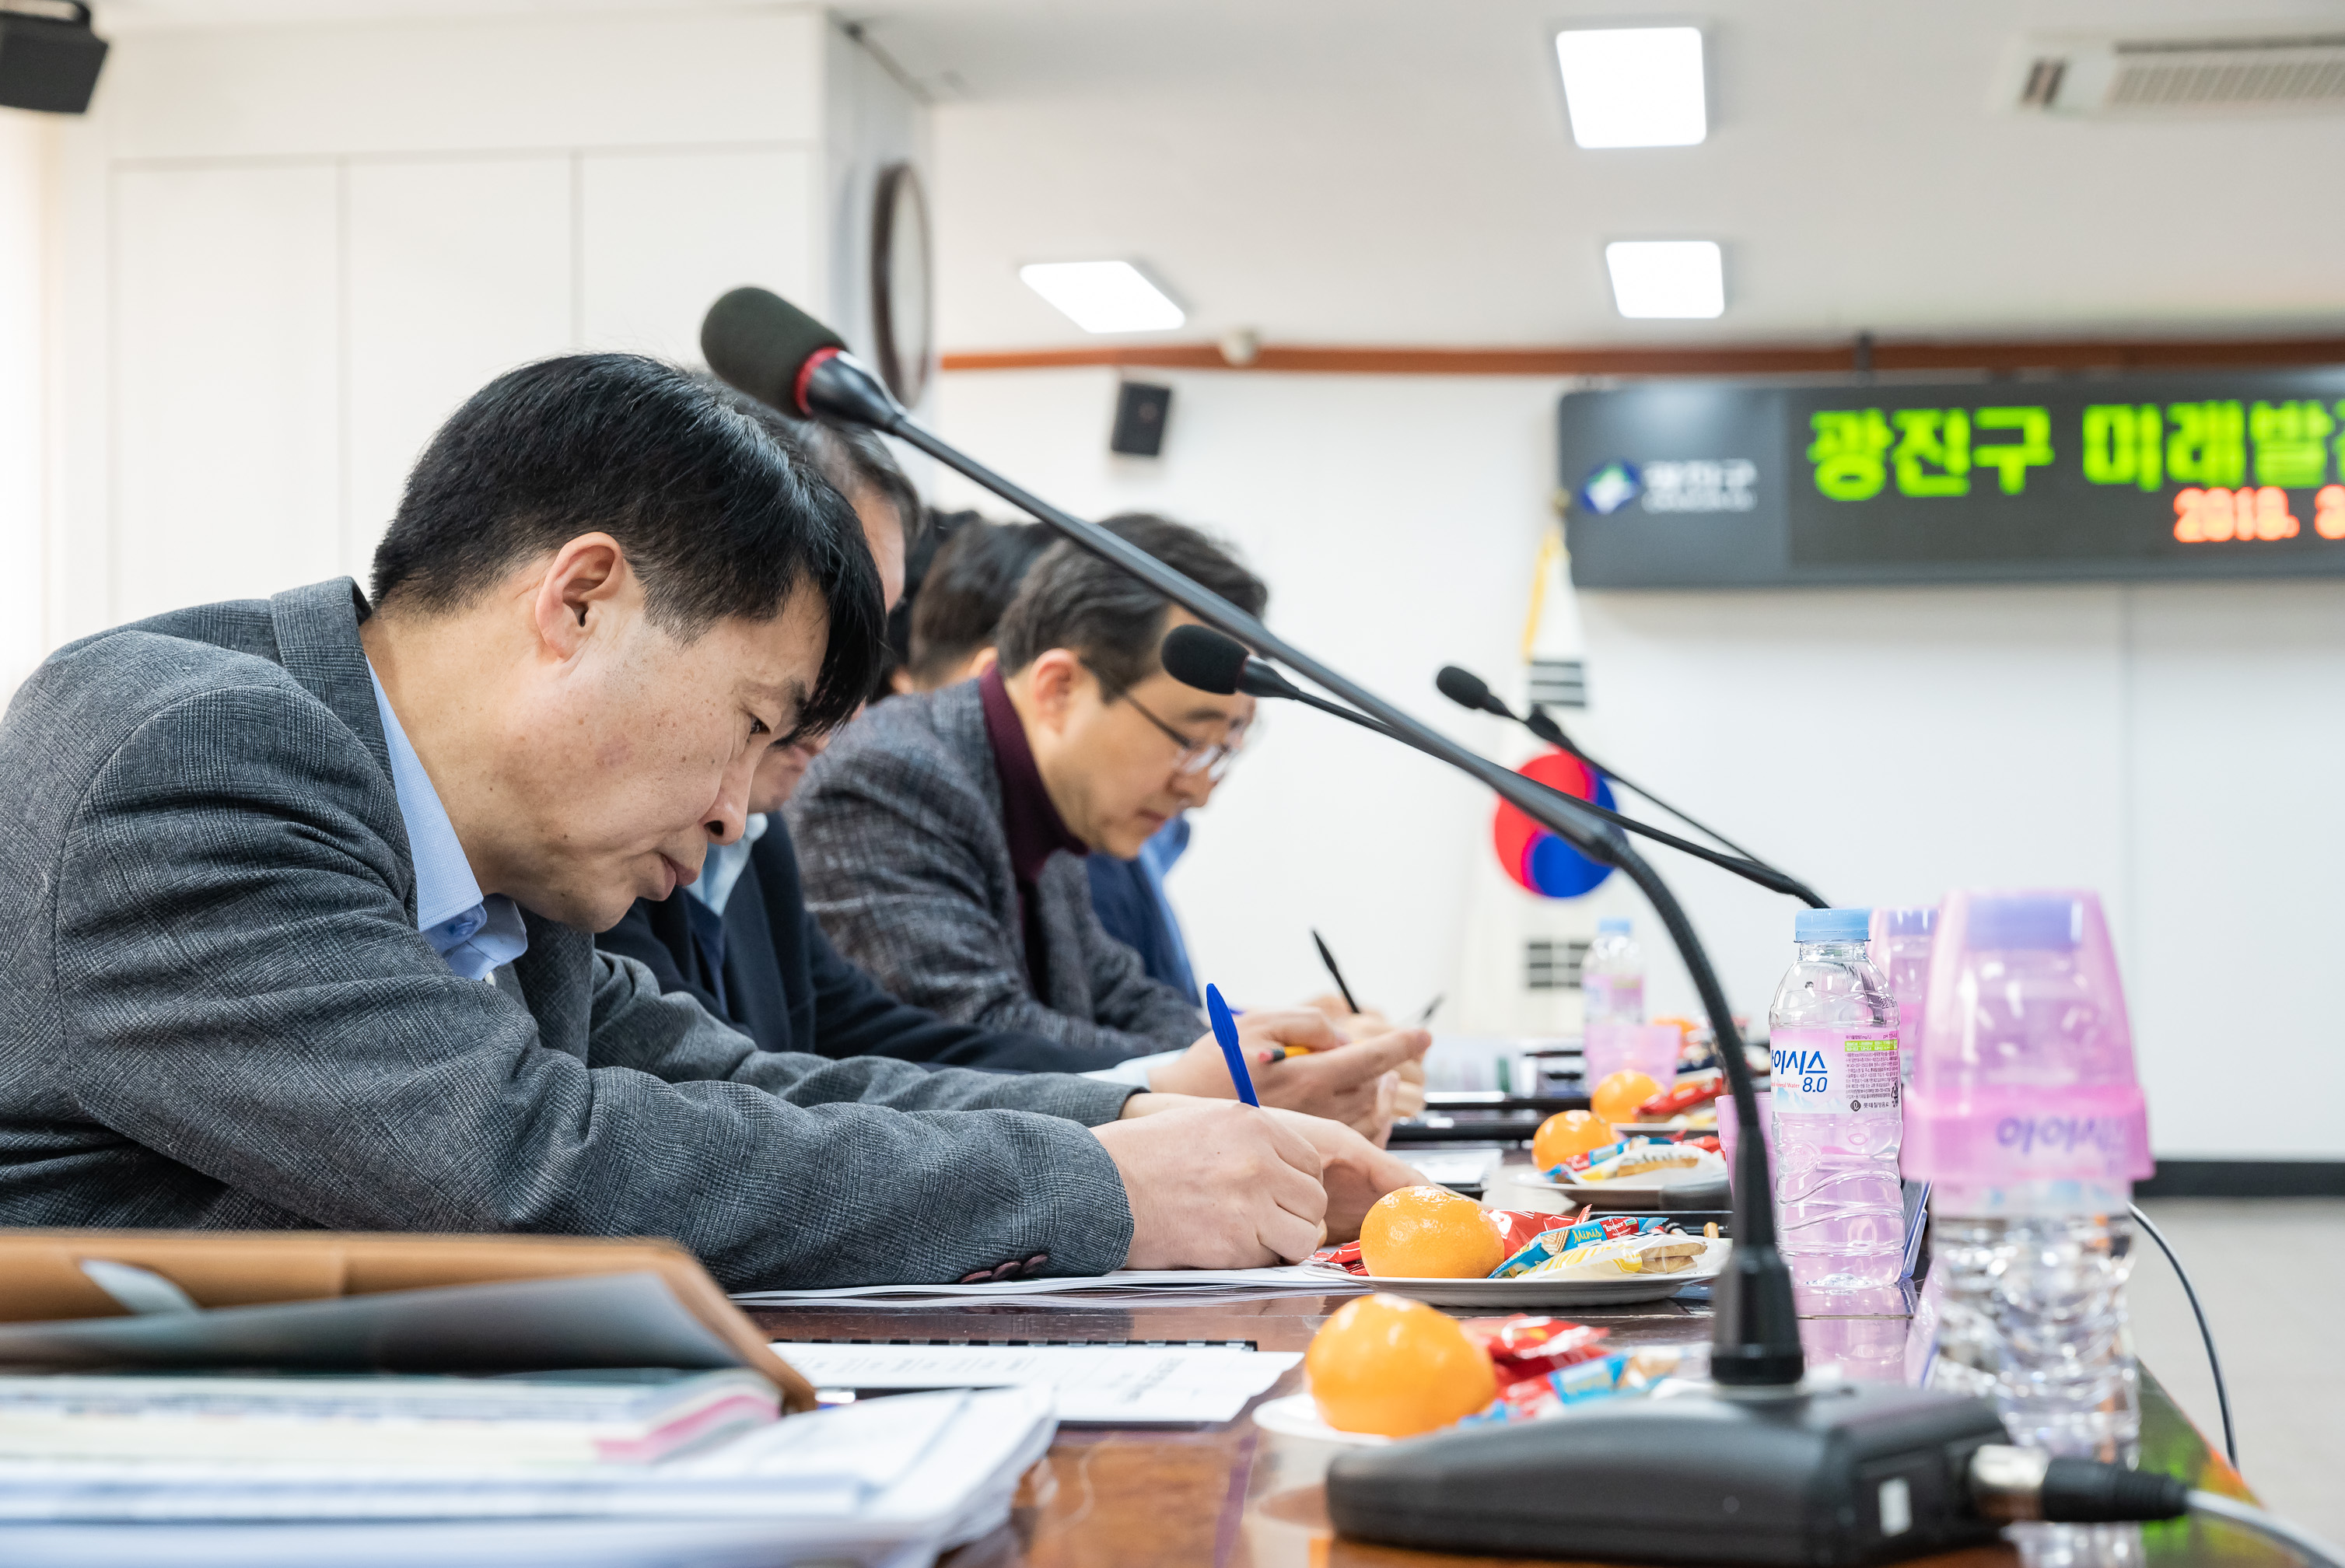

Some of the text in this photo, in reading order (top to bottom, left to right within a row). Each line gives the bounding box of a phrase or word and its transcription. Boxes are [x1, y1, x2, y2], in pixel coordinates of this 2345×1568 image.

[1807, 399, 2345, 502] 광진구 미래발
[1802, 1076, 1828, 1093] 8.0
[1572, 1227, 1602, 1244] Minis
